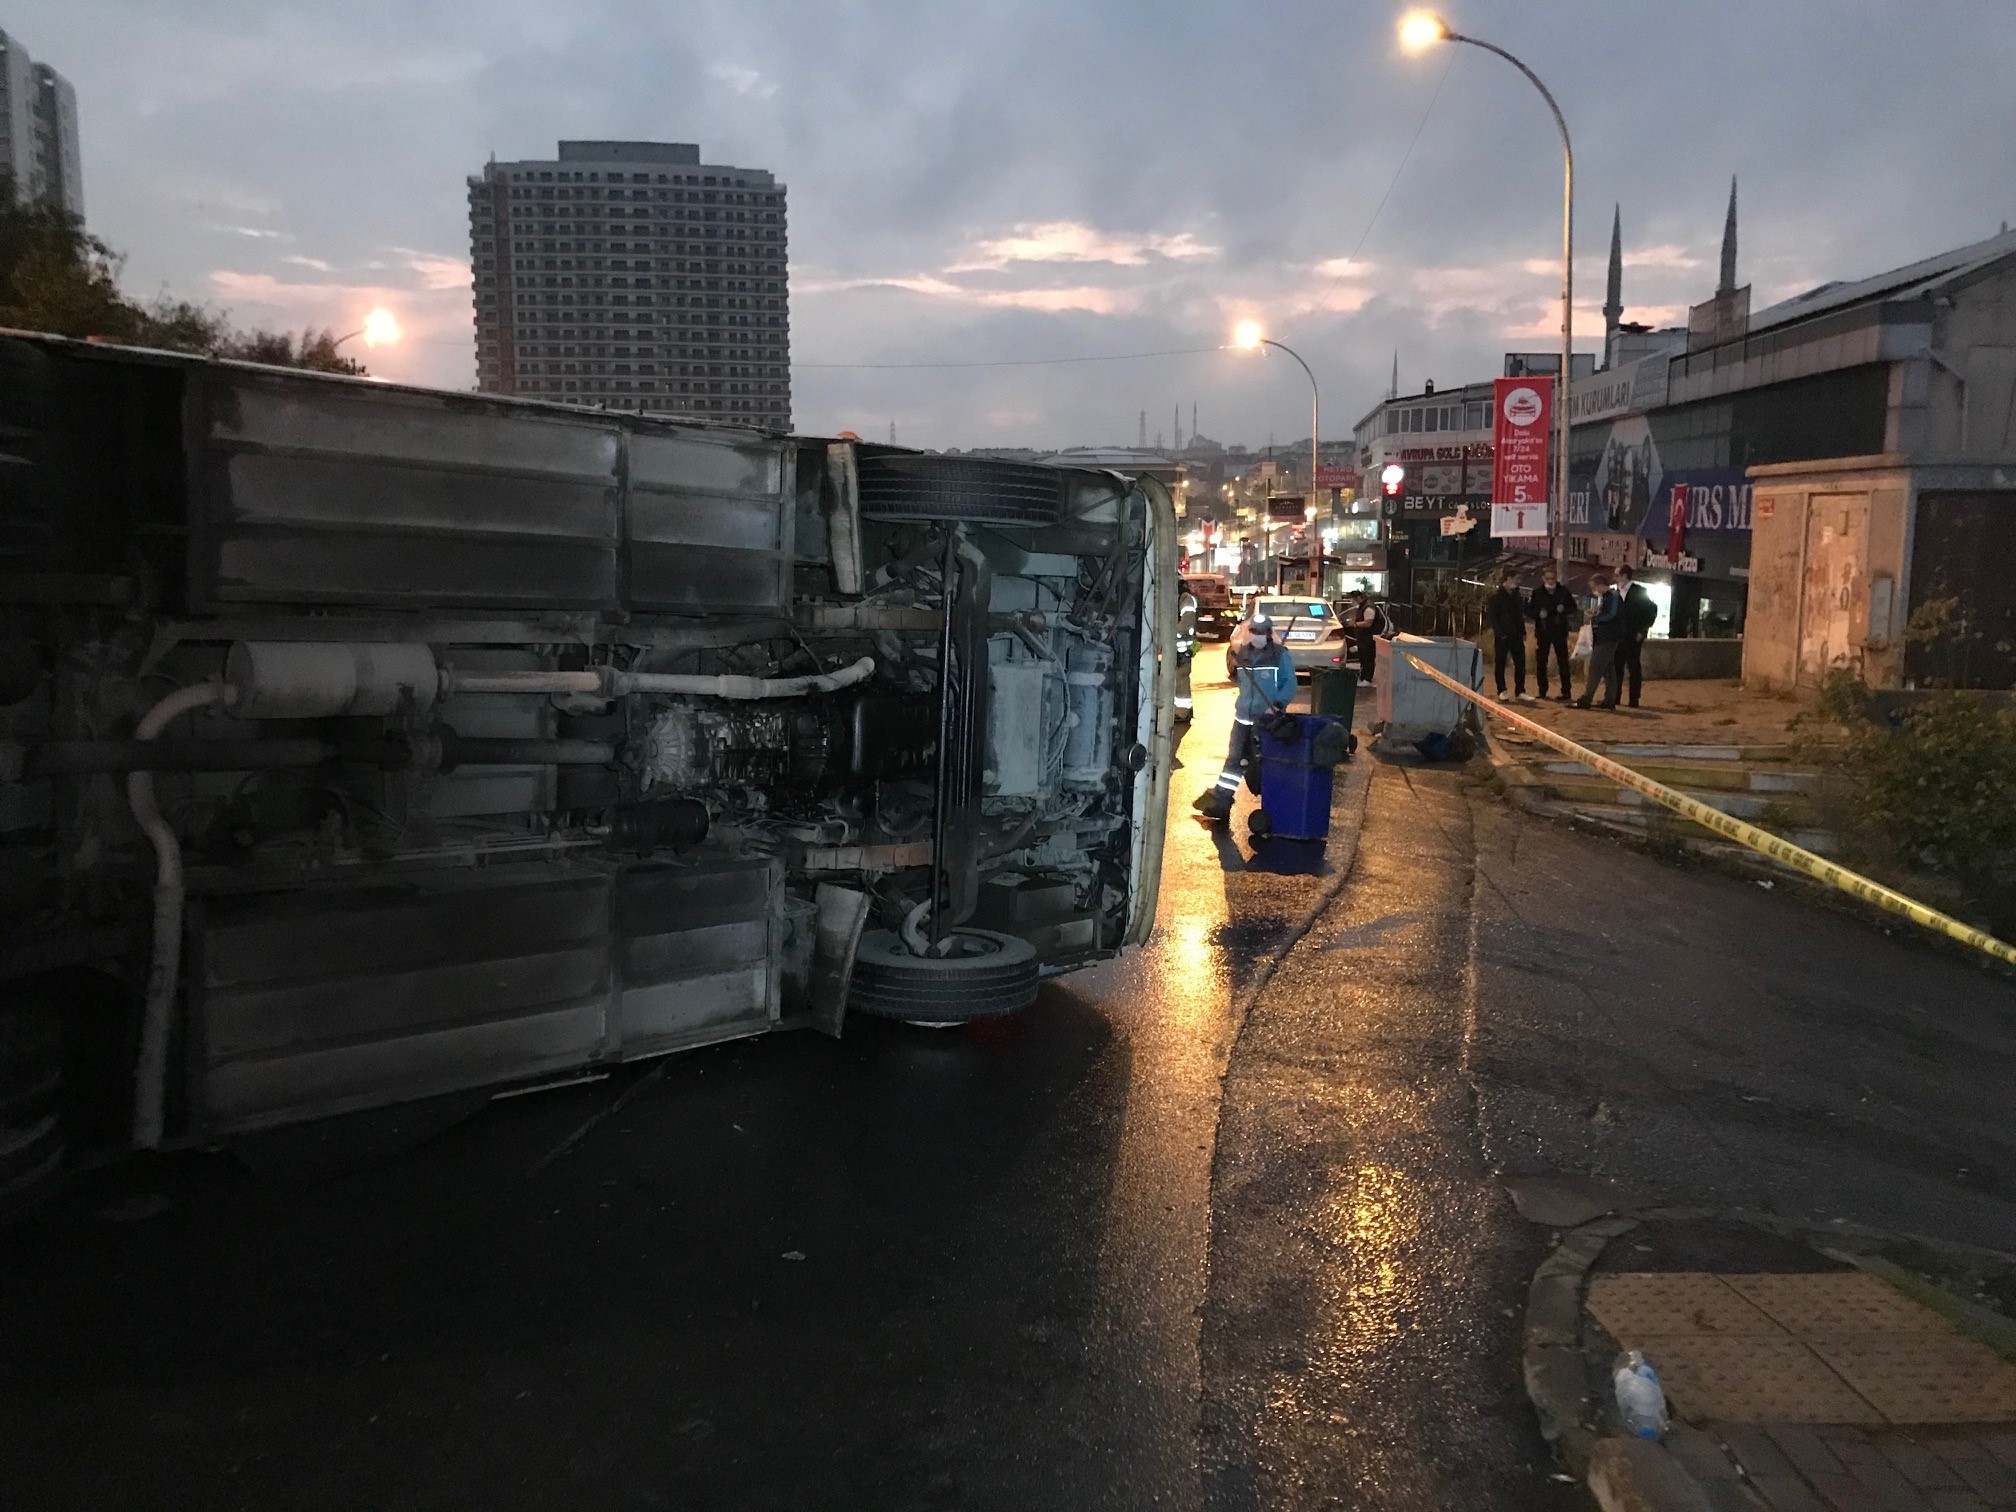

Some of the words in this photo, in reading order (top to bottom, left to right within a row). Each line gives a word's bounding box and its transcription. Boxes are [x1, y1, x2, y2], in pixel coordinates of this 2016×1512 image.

[1580, 380, 1631, 416] KURUMLARI
[1401, 448, 1435, 461] AVRUPA
[1437, 445, 1461, 459] GOLD
[1323, 466, 1353, 474] METRO
[1510, 464, 1532, 474] OTO
[1317, 474, 1357, 483] OTOPARK
[1503, 474, 1539, 483] YIKAMA
[1513, 485, 1527, 503] 5
[1404, 496, 1446, 510] BEYT
